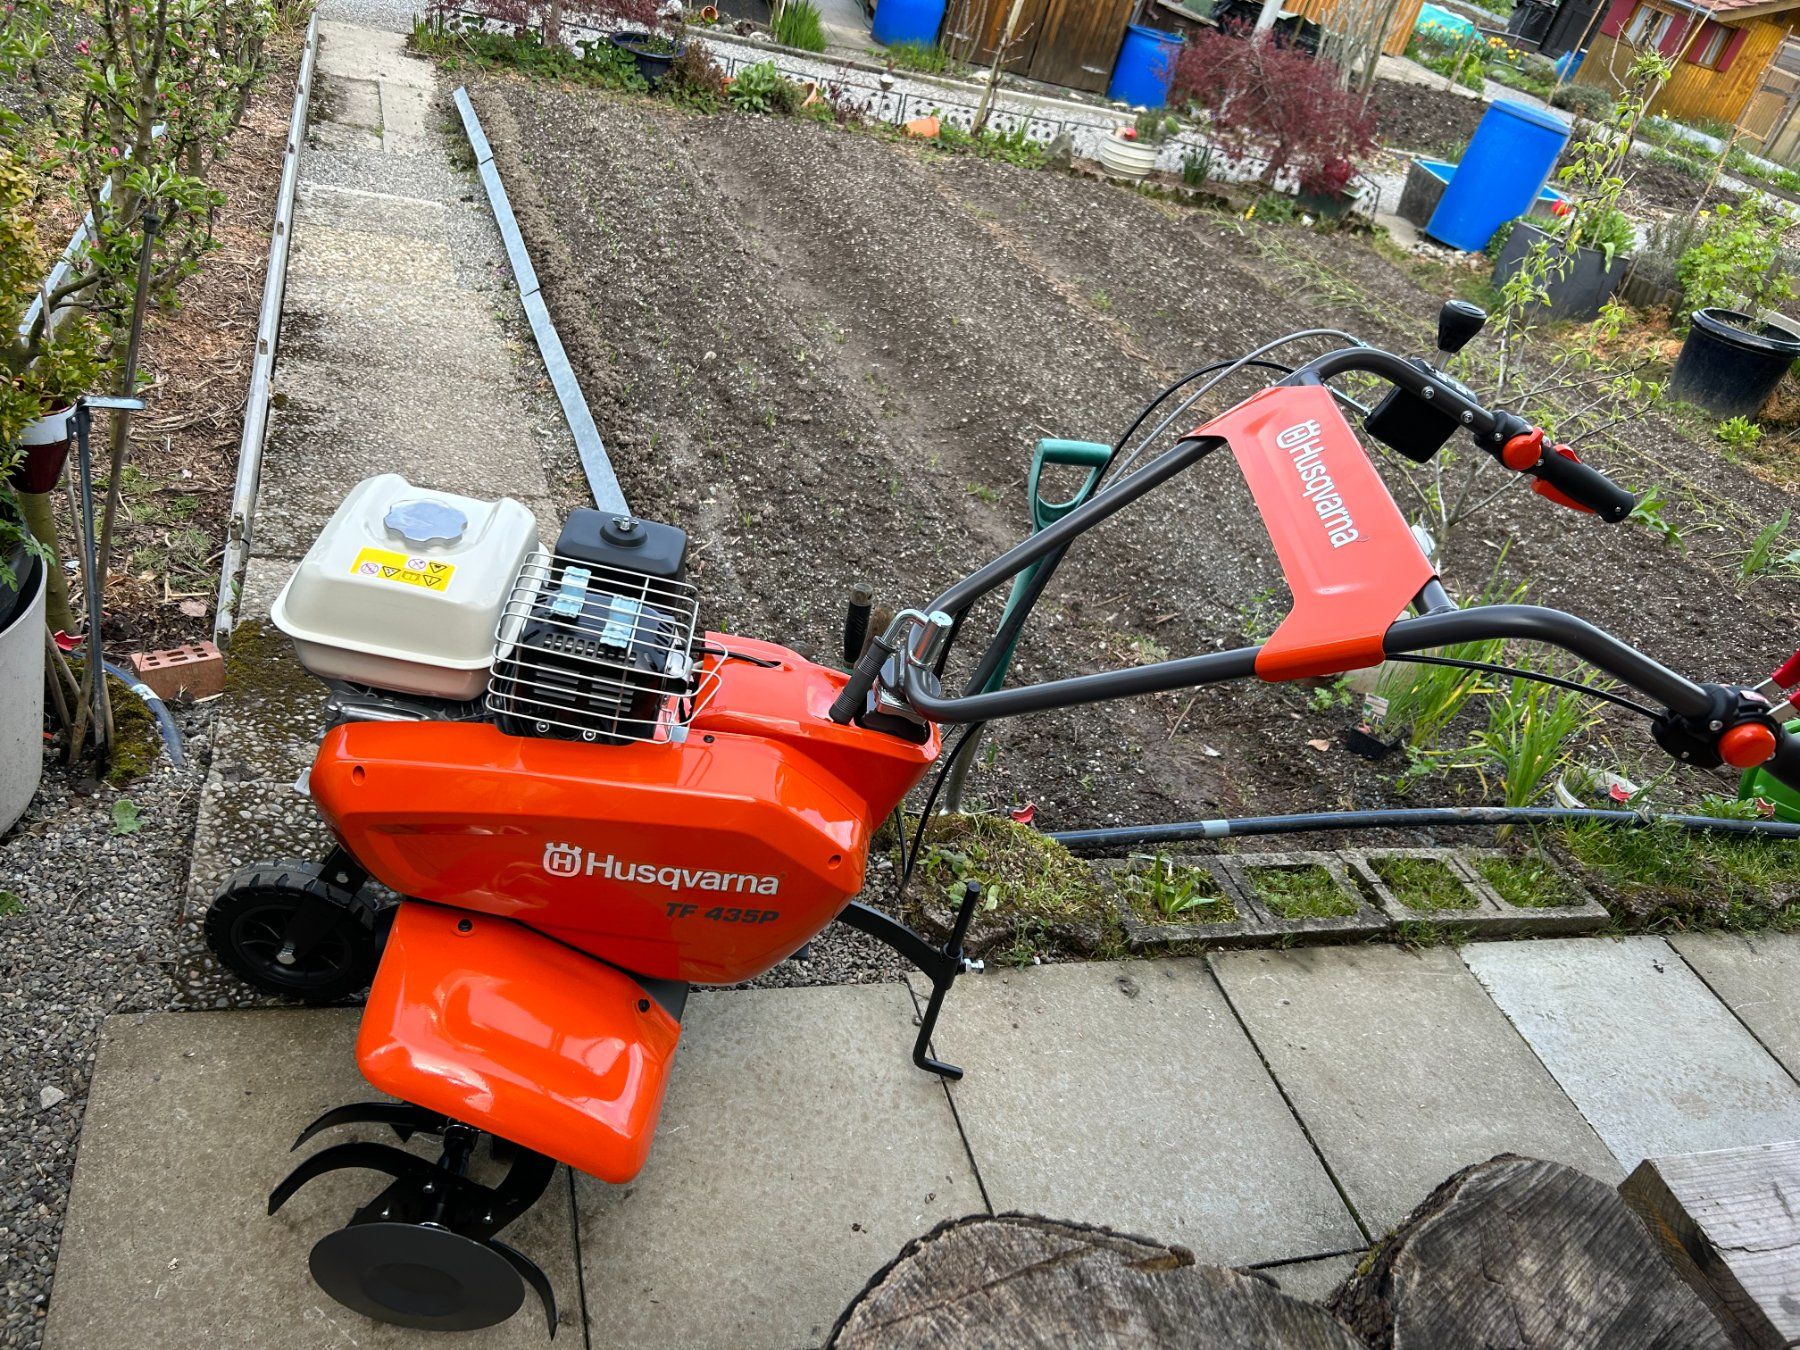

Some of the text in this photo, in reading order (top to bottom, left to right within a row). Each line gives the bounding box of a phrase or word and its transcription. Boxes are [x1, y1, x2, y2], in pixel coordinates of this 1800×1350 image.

[1289, 438, 1359, 549] Husqvarna
[586, 852, 779, 895] Husqvarna
[666, 902, 780, 925] TF 435P
